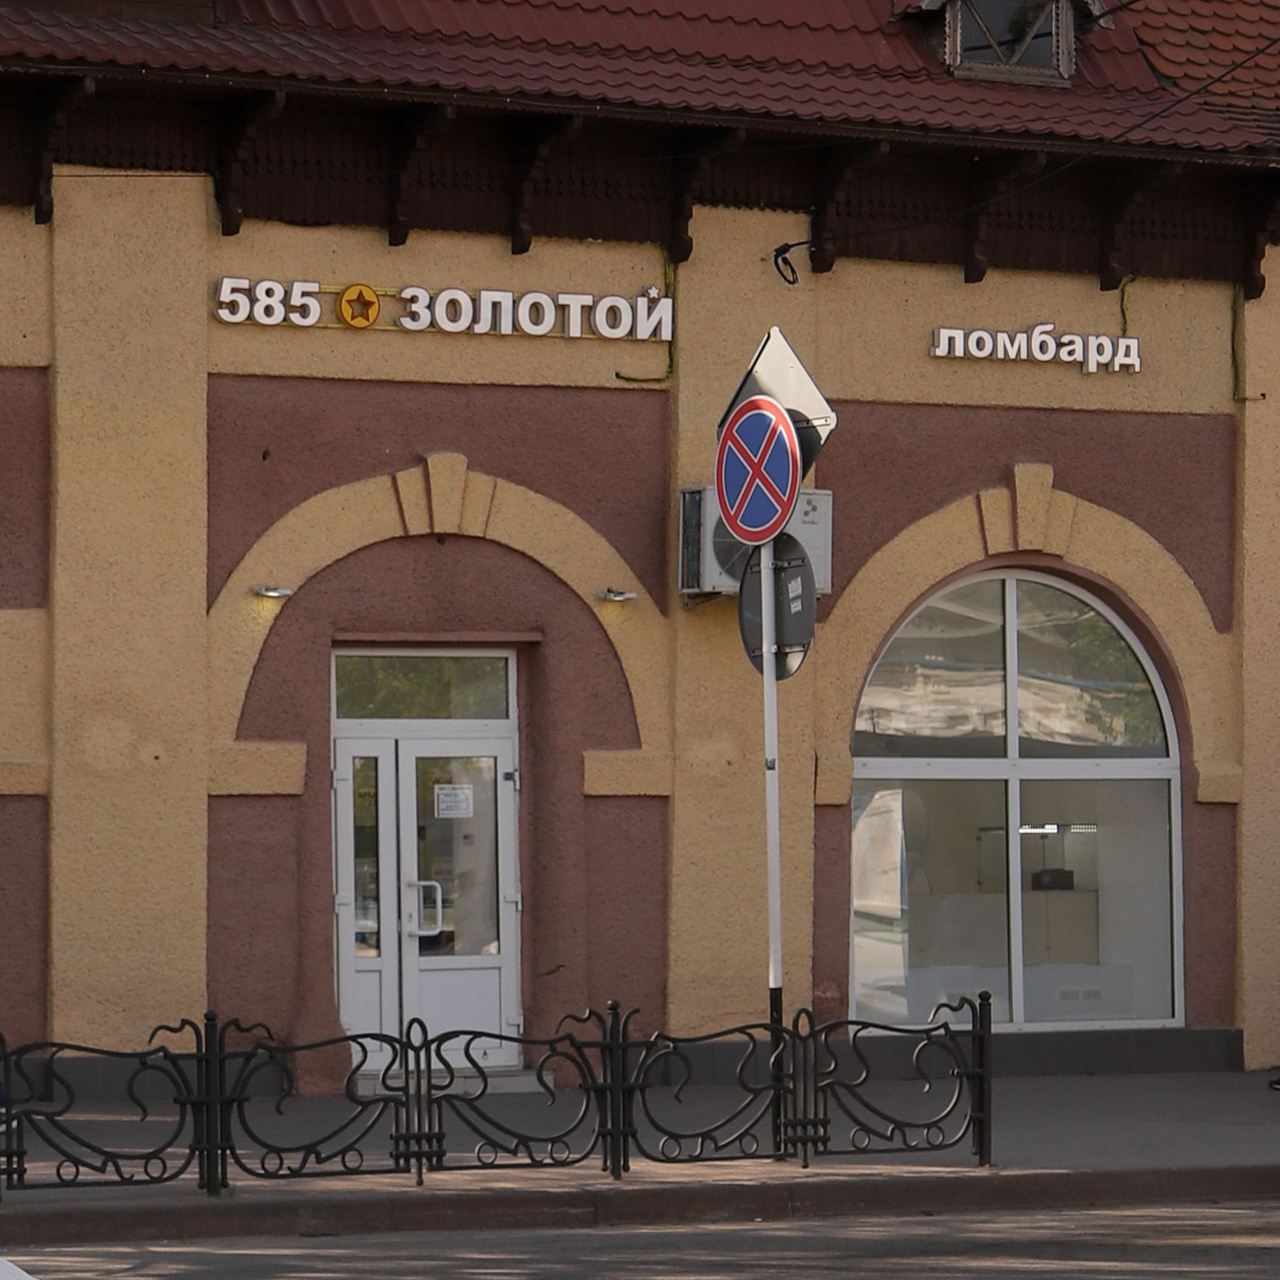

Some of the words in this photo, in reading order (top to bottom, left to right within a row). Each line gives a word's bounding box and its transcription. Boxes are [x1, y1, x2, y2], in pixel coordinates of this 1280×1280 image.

[215, 276, 322, 327] 585
[397, 284, 673, 342] ЗОЛОТОЙ
[931, 323, 1142, 374] ломбард
